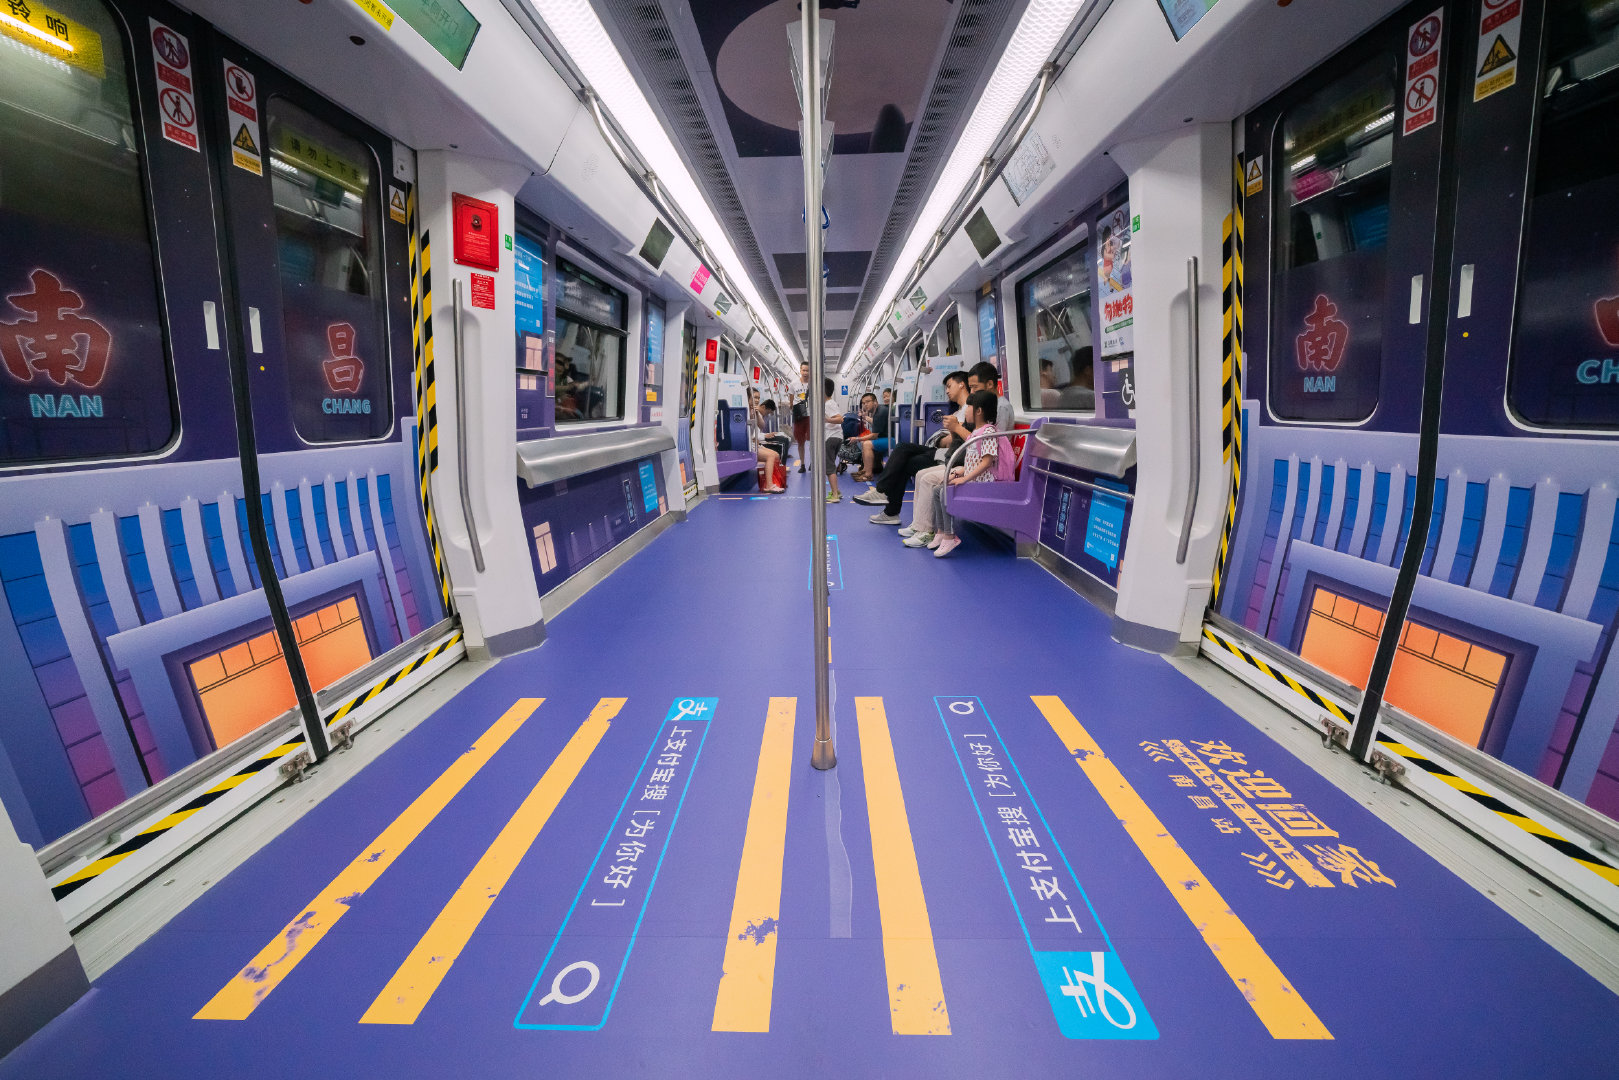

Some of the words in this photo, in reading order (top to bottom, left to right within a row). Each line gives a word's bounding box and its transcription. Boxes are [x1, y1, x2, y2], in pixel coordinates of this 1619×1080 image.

[0, 268, 112, 389] 南
[322, 322, 365, 393] 昌
[1296, 294, 1350, 372] 南
[29, 394, 104, 418] NAN
[321, 398, 371, 414] CHANG
[1303, 376, 1337, 392] NAN
[1168, 774, 1242, 834] 南昌站
[1178, 750, 1246, 810] WELCOME
[1245, 816, 1300, 862] HOME
[1190, 739, 1398, 888] 欢迎回家
